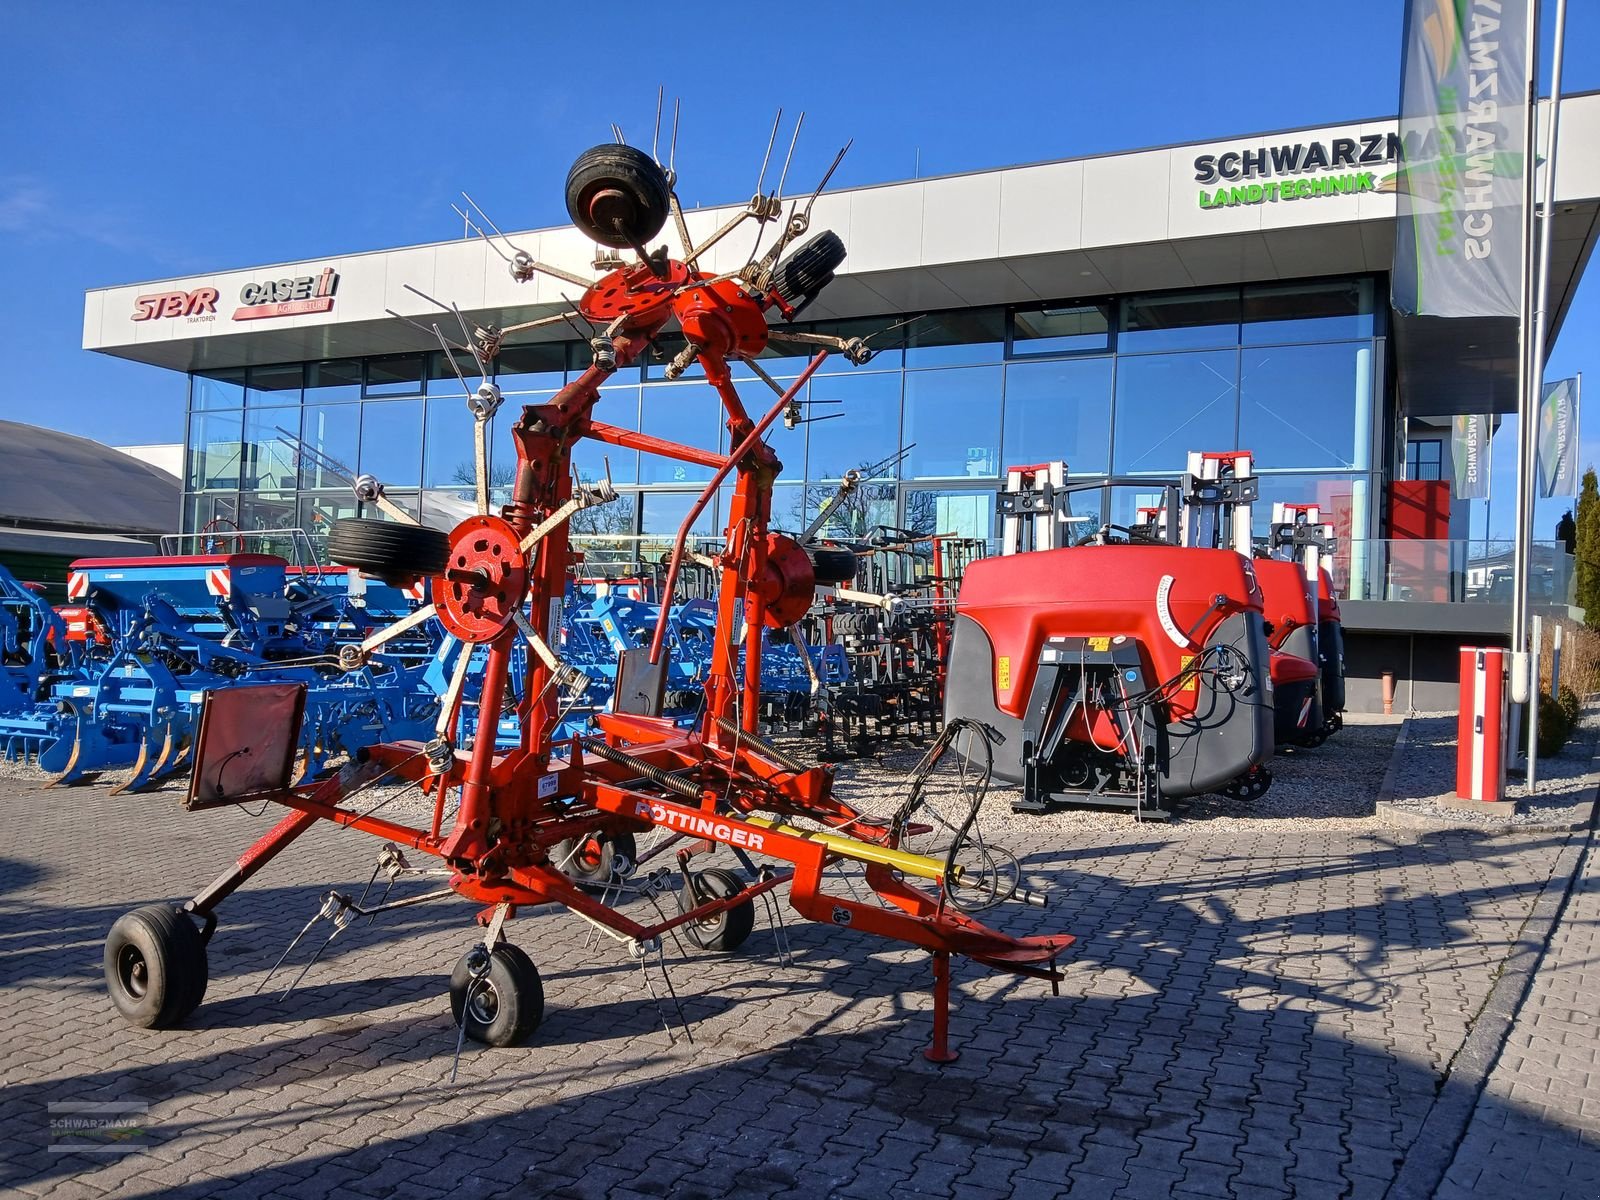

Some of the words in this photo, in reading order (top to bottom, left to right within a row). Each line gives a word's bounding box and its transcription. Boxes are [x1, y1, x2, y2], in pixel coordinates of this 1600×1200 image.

[1200, 172, 1374, 209] LANDTECHNIK
[131, 286, 219, 322] STEYR
[239, 276, 313, 305] CASE
[186, 315, 216, 324] TRAKTOREN
[635, 801, 765, 850] PÖTTINGER
